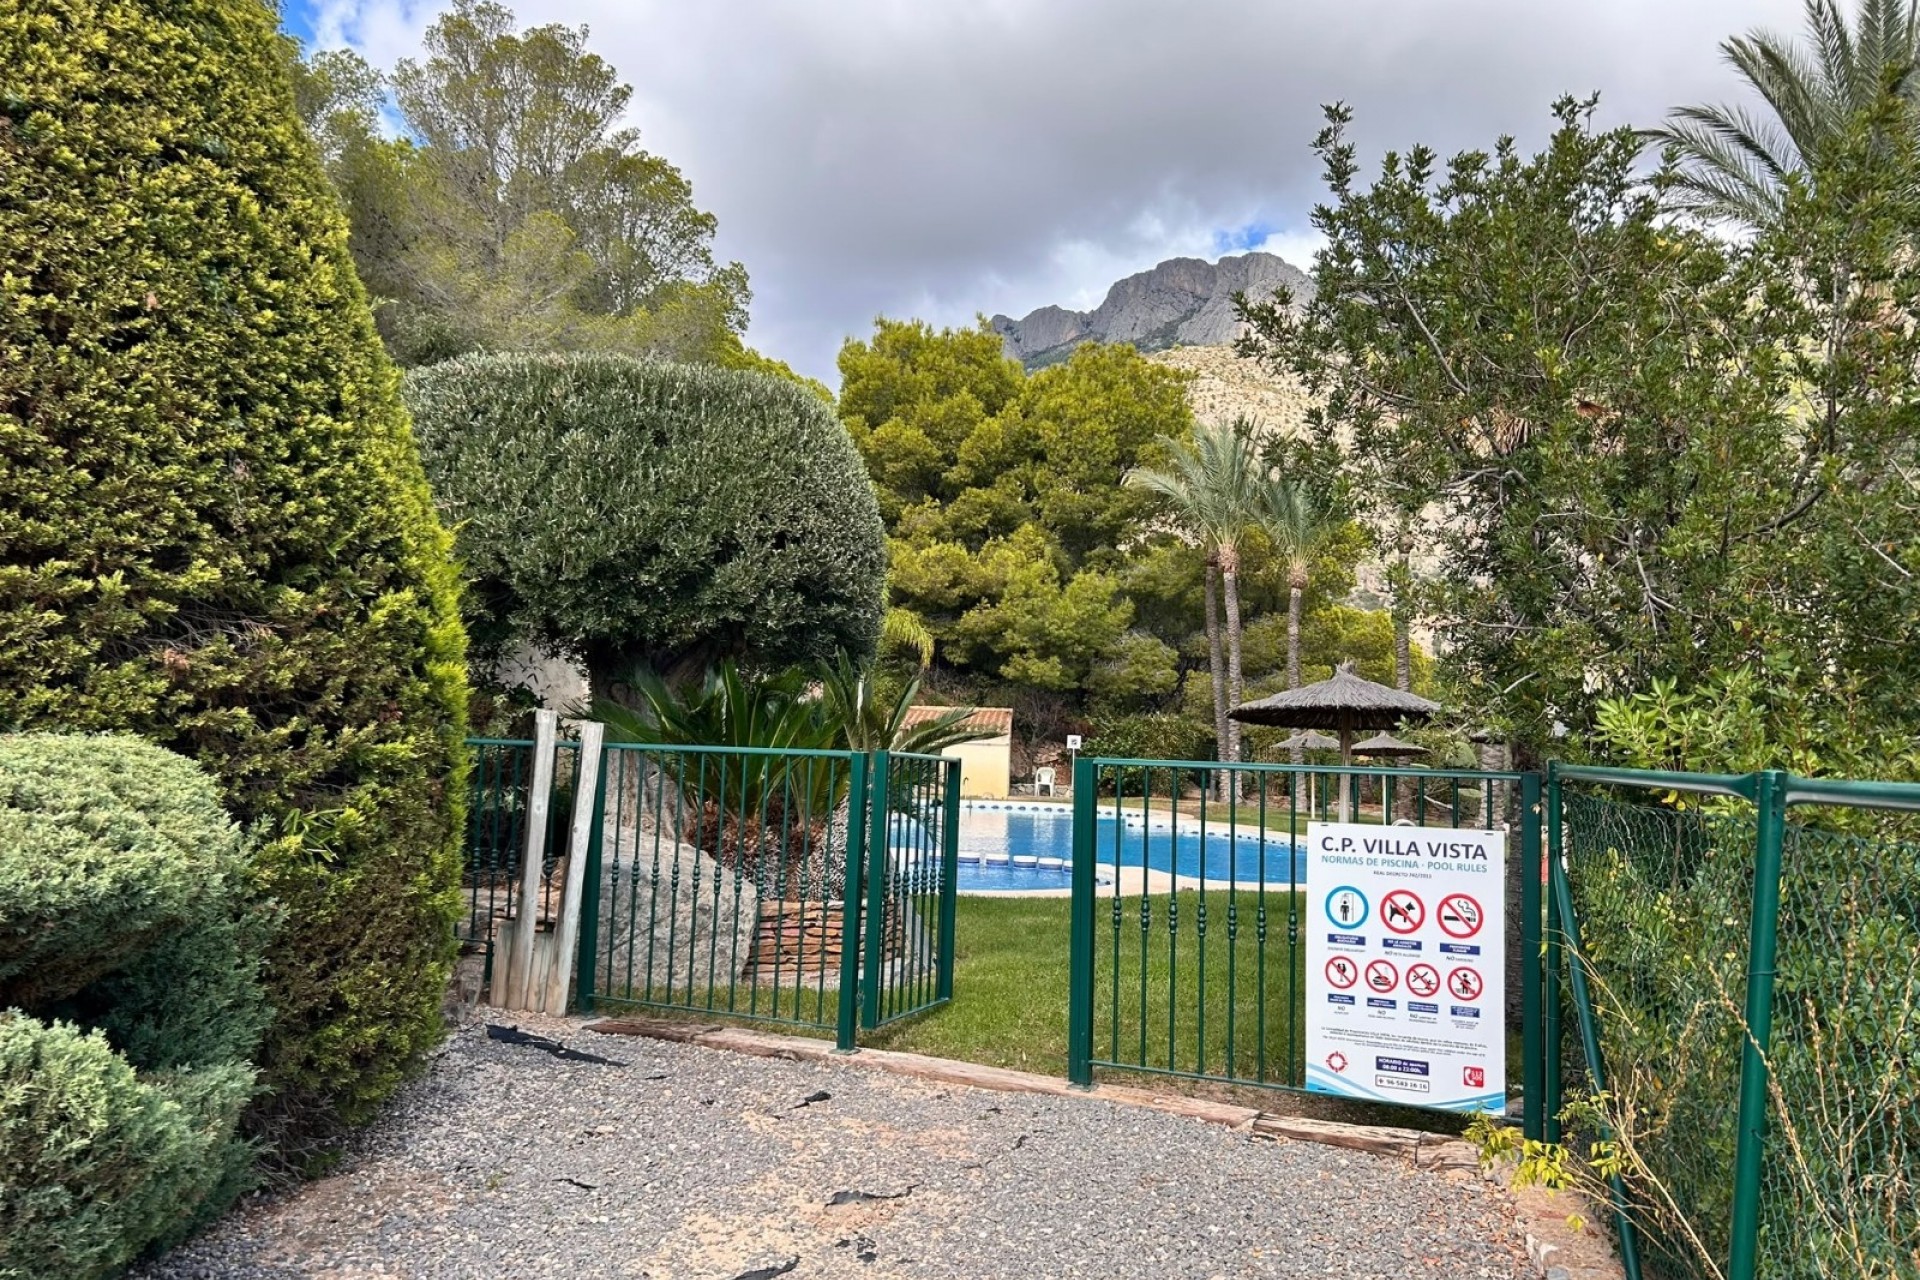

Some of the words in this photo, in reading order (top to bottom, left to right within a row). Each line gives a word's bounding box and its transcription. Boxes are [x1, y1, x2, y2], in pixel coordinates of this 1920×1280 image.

[1321, 836, 1356, 853] C.P.
[1363, 838, 1420, 857] VILLA
[1427, 842, 1488, 860] VISTA
[1321, 855, 1364, 866] NORMAS
[1366, 858, 1379, 867] DE
[1381, 859, 1419, 869] PISCINA
[1427, 861, 1455, 871] POOL
[1457, 863, 1488, 873] RULES
